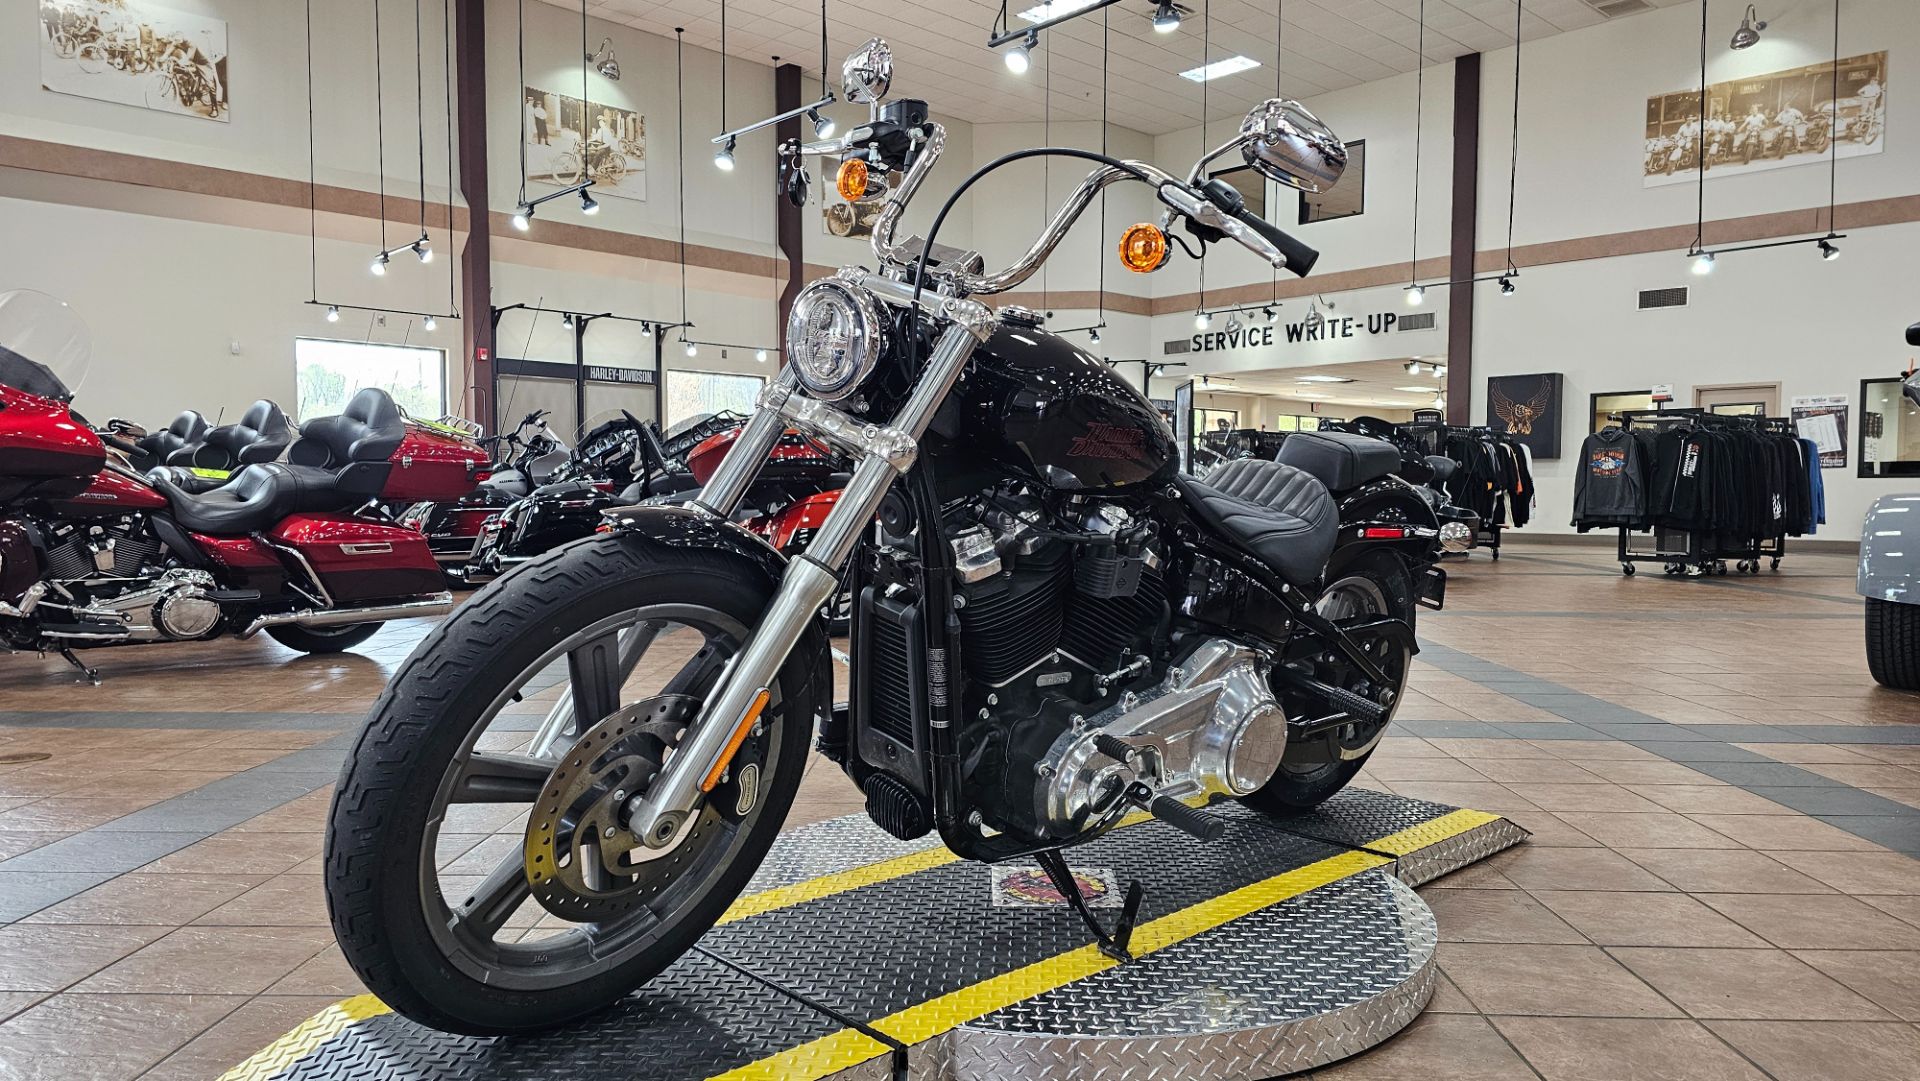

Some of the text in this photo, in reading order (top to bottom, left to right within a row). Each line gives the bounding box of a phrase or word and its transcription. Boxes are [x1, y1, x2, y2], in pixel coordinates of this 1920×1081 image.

[1192, 313, 1396, 352] SERVICE WRITE-UP
[590, 366, 652, 383] HARLEY-DAVIDSON
